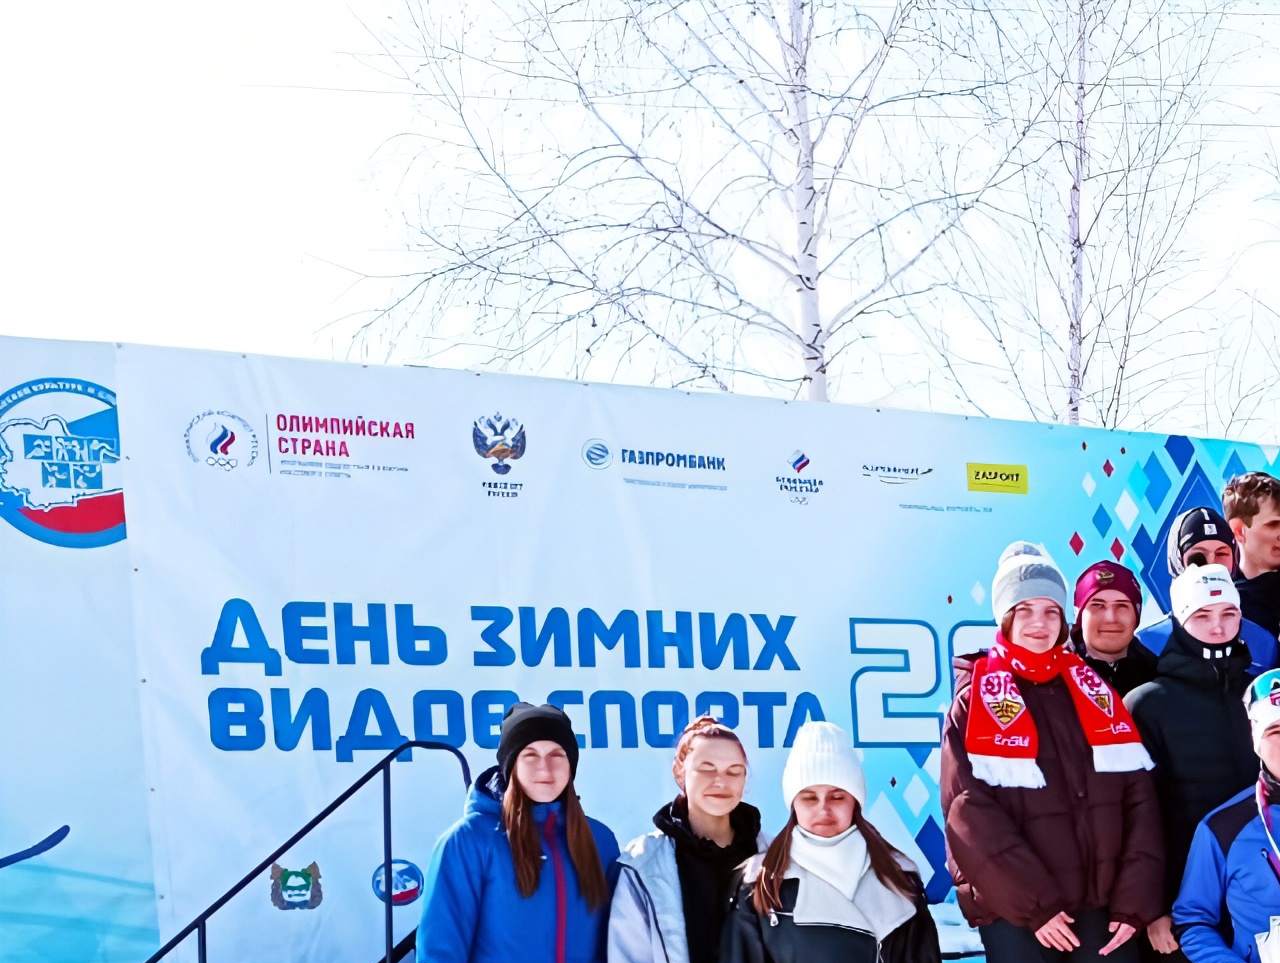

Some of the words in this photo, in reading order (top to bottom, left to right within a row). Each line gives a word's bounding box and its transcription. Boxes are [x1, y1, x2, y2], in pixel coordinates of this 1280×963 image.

[276, 413, 415, 439] ОЛИМПИЙСКАЯ
[277, 437, 350, 457] СТРАНА
[621, 448, 726, 471] ГАЗПРОМБАНК
[200, 598, 448, 677] ДЕНЬ
[470, 605, 801, 671] ЗИМНИХ
[208, 686, 520, 763] ВИДОВ
